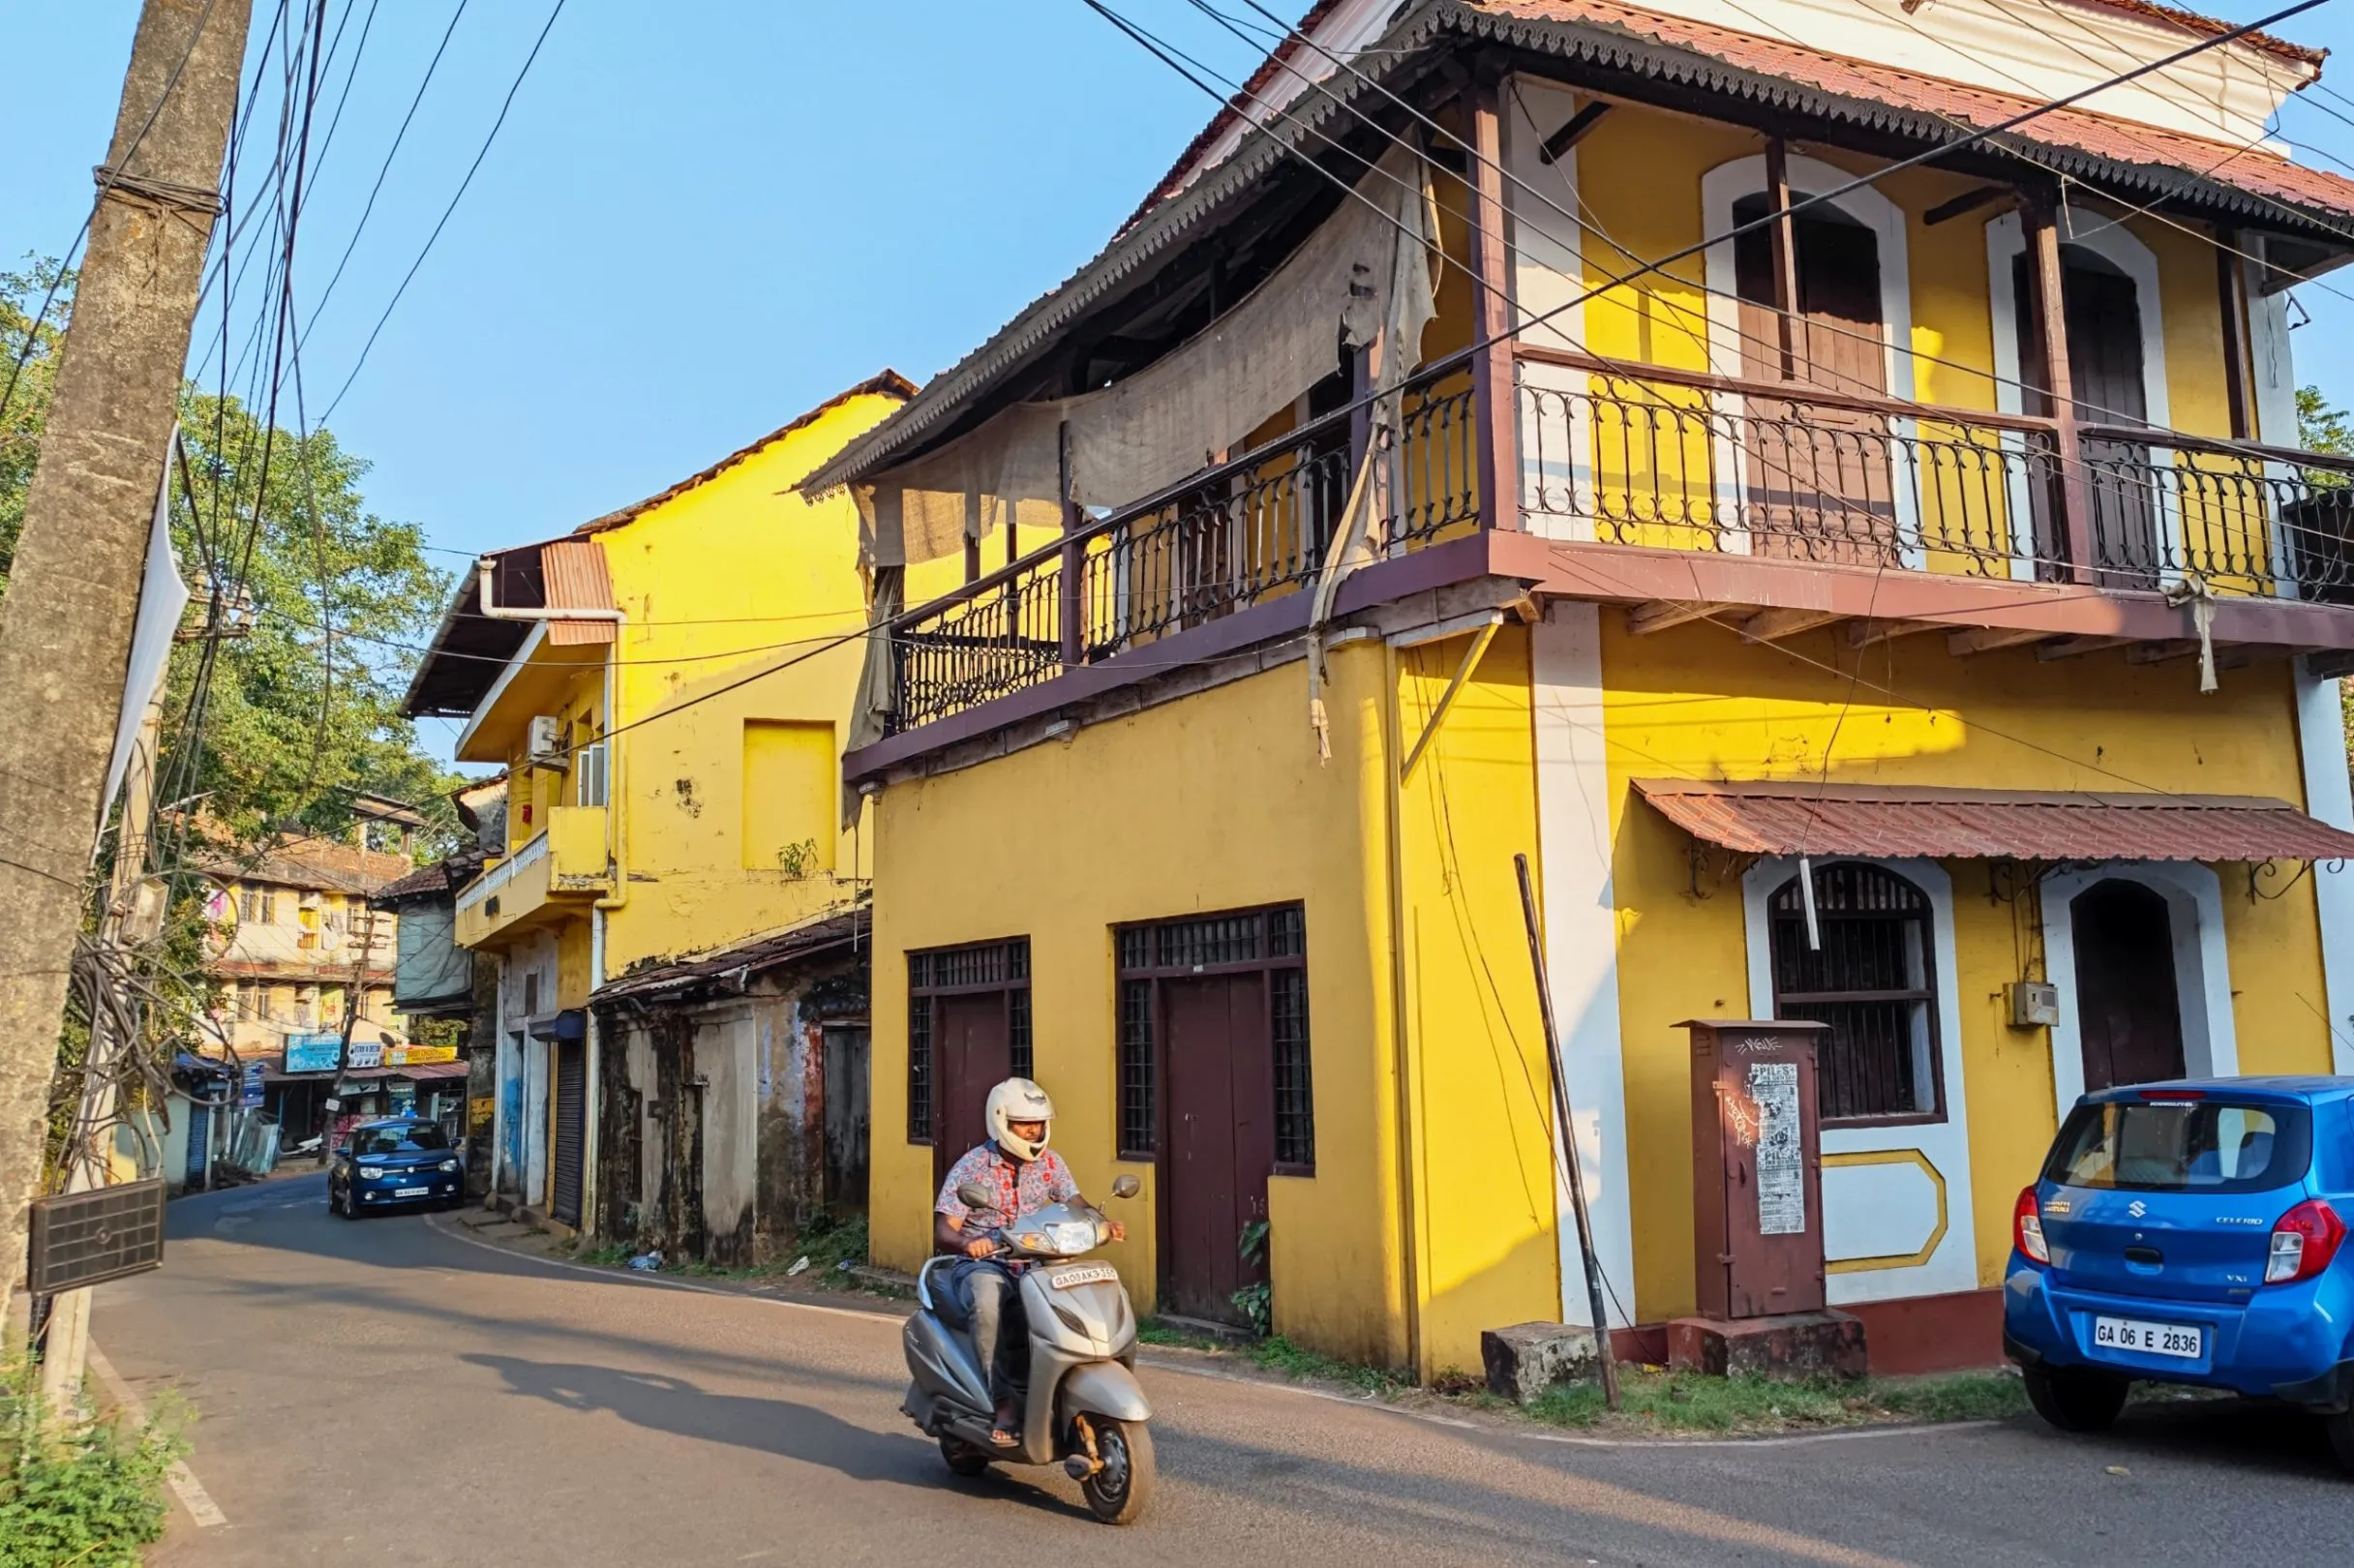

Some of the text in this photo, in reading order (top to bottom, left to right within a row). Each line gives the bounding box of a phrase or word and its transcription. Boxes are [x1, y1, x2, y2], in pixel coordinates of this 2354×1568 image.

[2216, 1217, 2264, 1225] CELERIO
[2097, 1325, 2197, 1353] GA 06 E 2836
